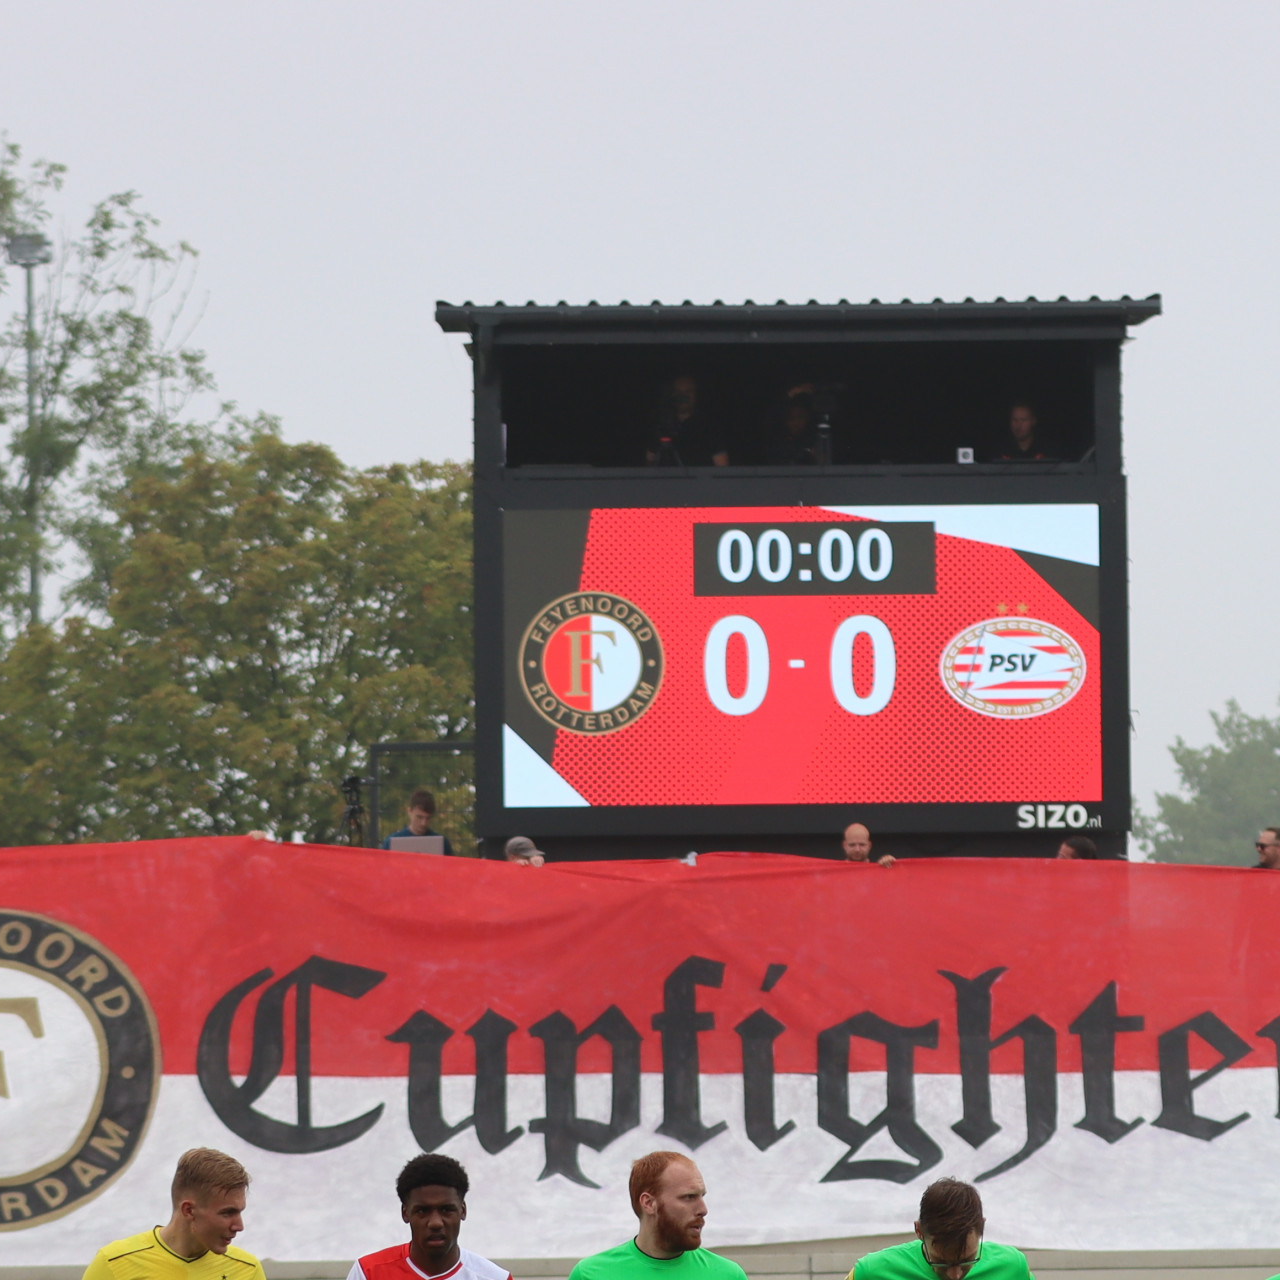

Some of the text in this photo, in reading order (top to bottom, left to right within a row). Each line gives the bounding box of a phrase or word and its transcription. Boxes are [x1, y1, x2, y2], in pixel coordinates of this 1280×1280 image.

[717, 528, 893, 583] 00:00
[531, 596, 652, 643] FEYENOORD
[564, 630, 617, 697] F
[704, 614, 770, 716] 0
[830, 614, 896, 716] 0
[988, 653, 1037, 673] PSV
[531, 681, 654, 729] ROTTERDAM
[1017, 804, 1102, 829] SIZO.nl
